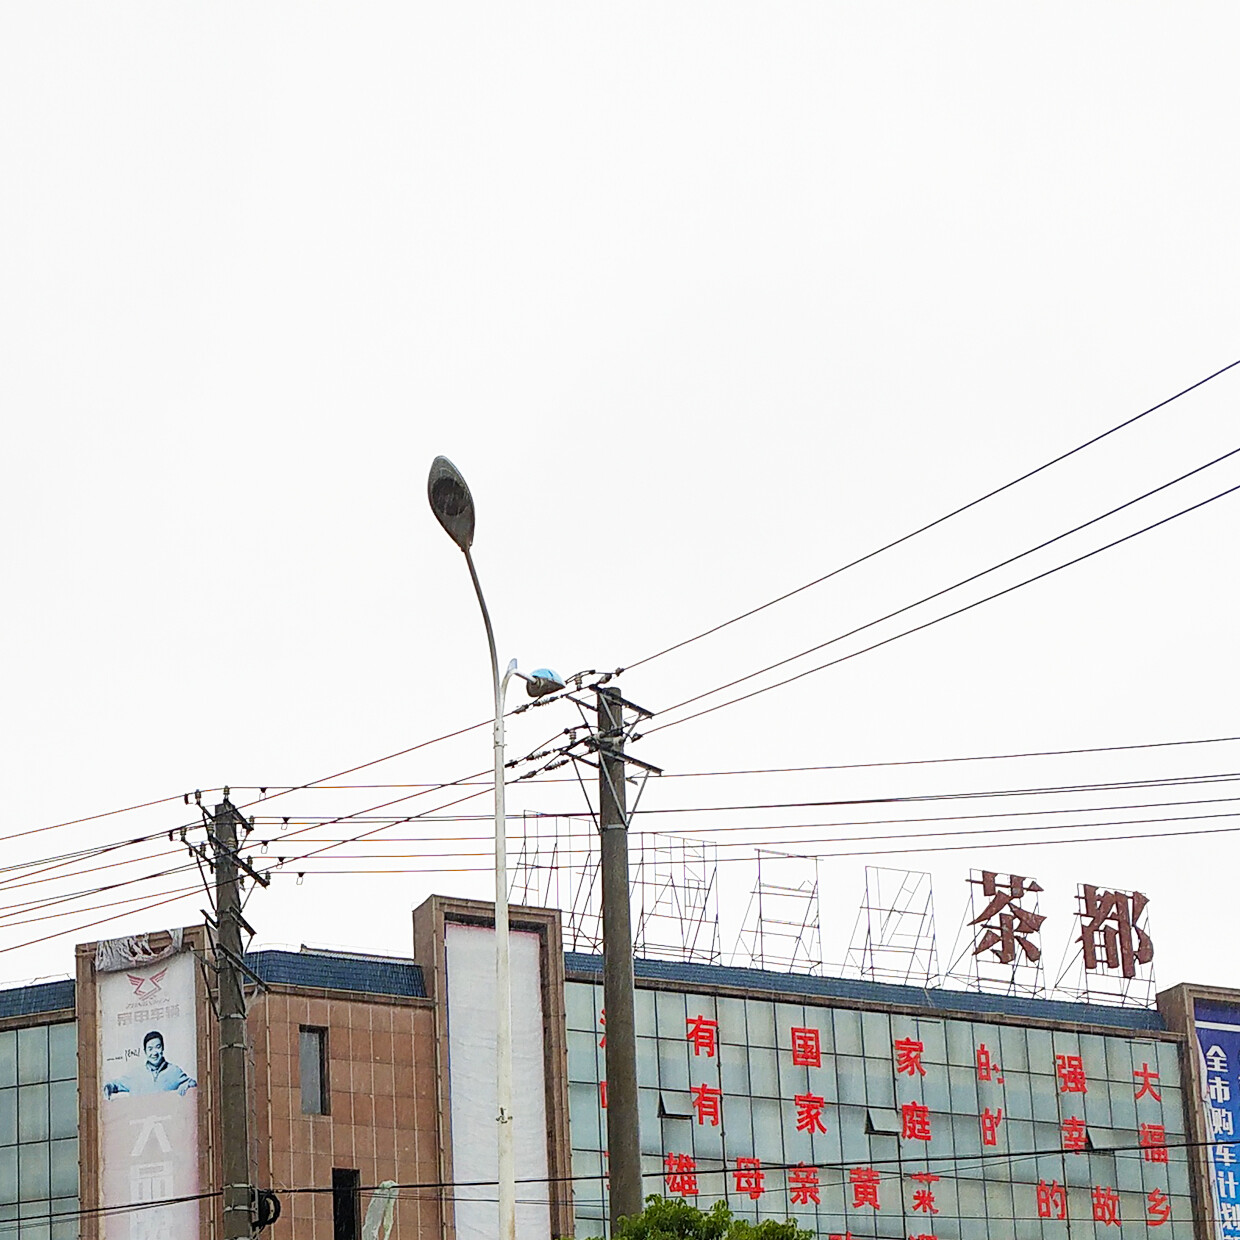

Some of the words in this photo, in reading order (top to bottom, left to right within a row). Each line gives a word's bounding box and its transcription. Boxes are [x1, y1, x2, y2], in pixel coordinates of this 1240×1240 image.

[966, 871, 1154, 979] 茶都
[599, 1010, 1162, 1101] 有国家的强大
[600, 1081, 1169, 1164] 有家庭的幸福
